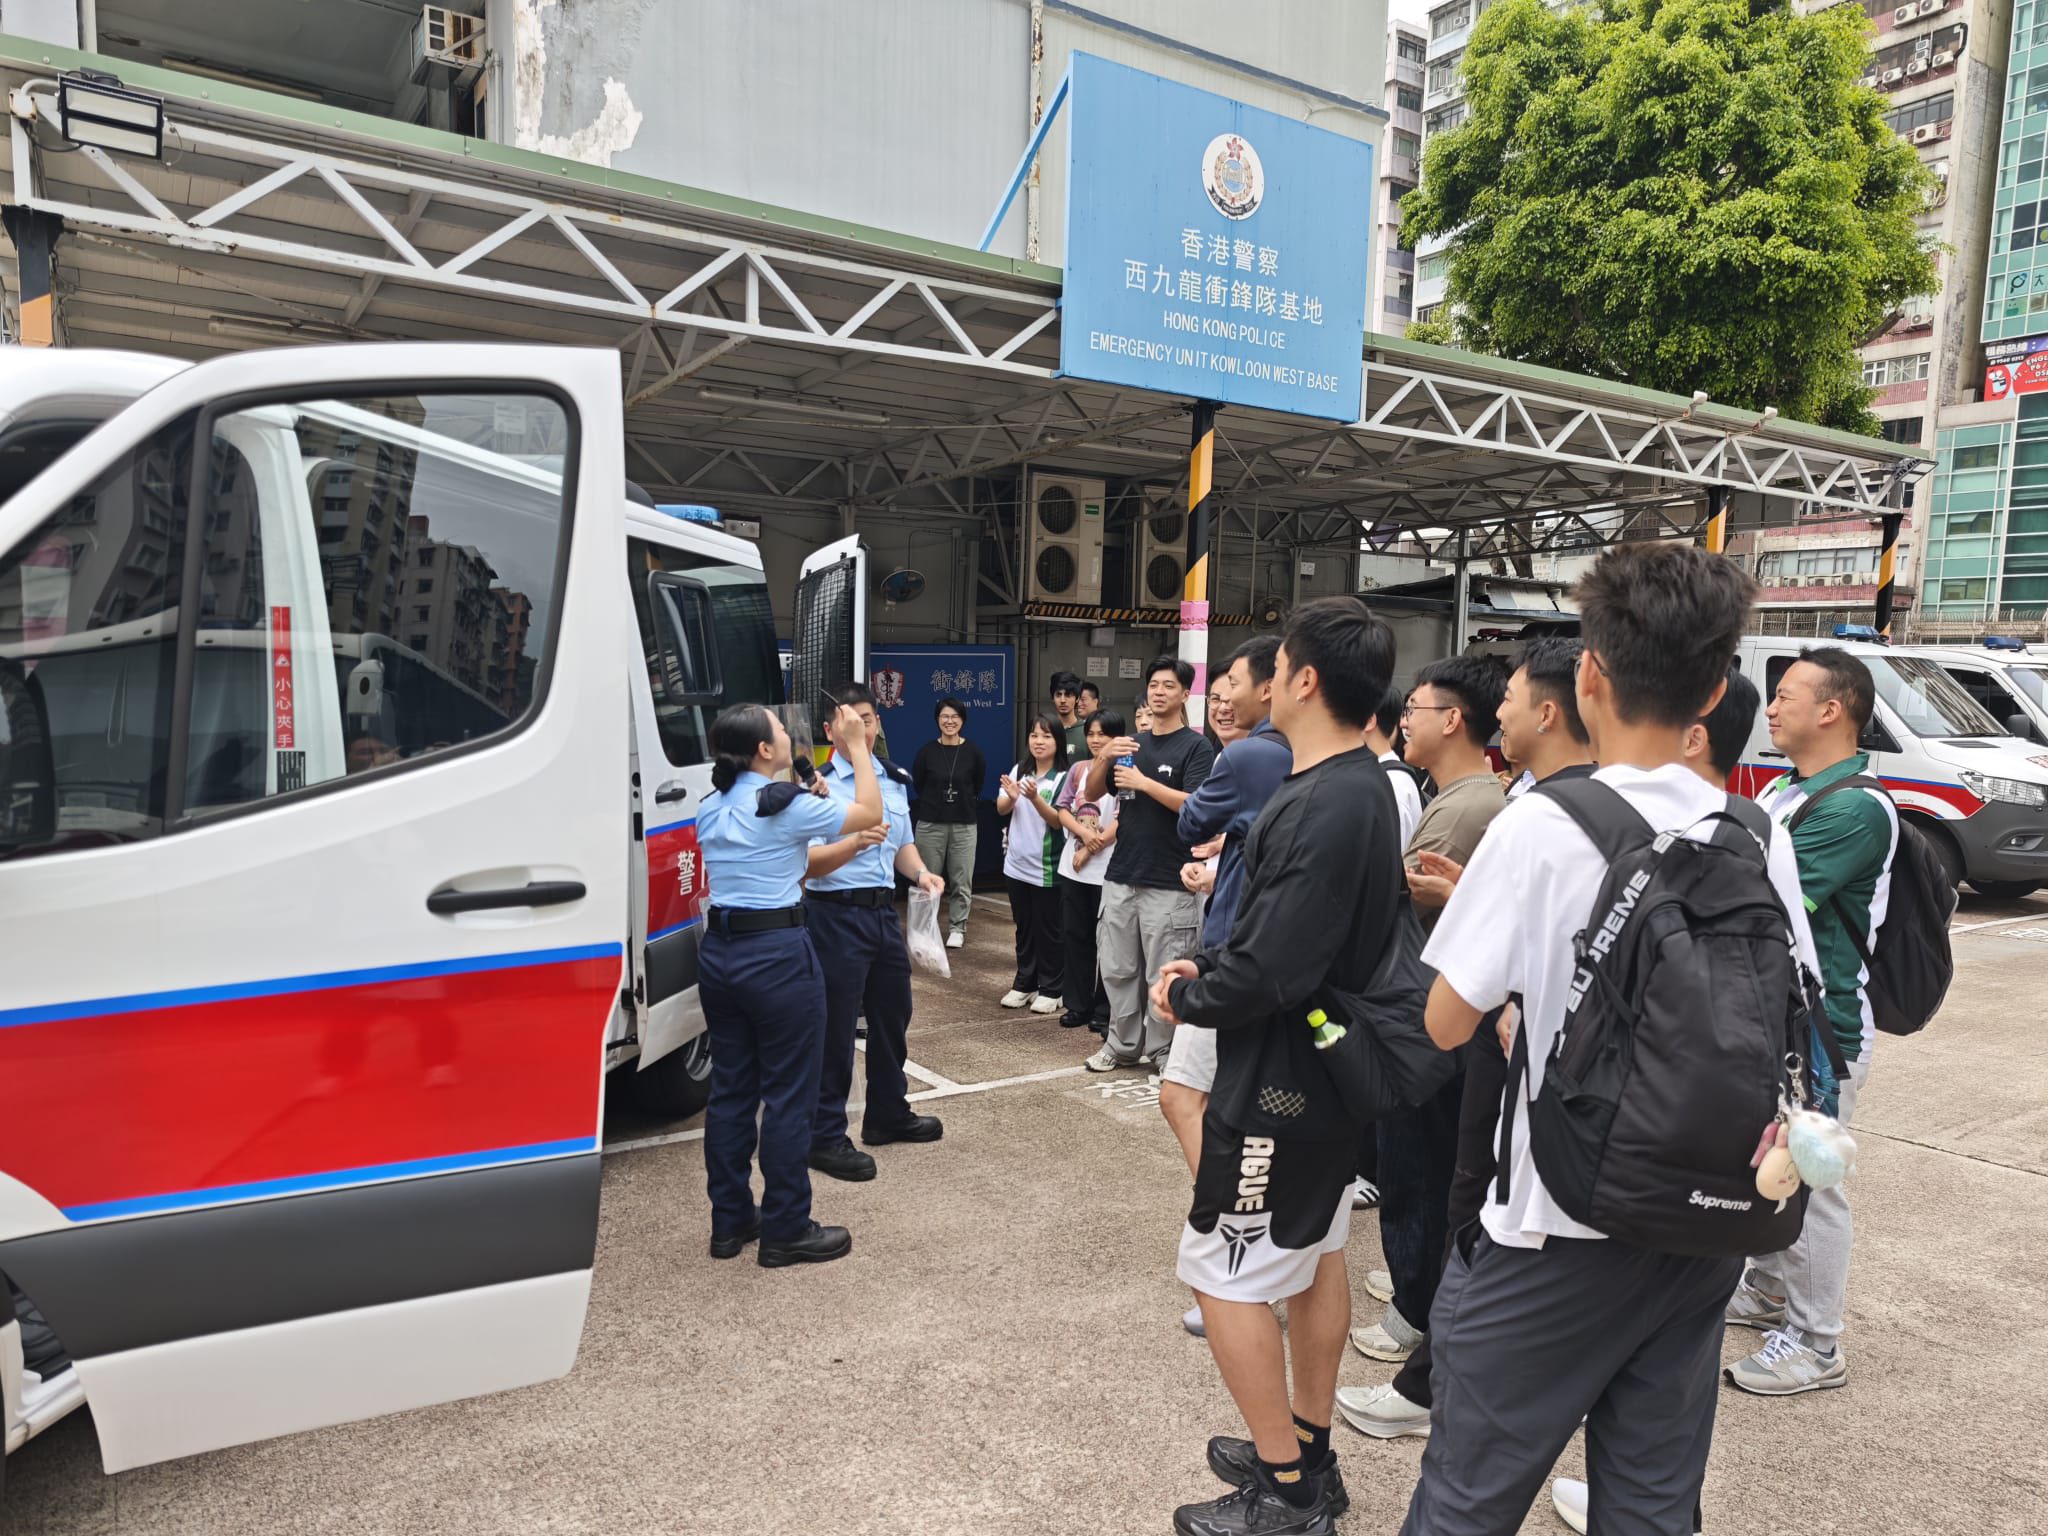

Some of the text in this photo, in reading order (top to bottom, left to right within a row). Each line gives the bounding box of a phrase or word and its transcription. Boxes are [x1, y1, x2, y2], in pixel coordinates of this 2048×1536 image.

[1181, 228, 1279, 277] 香港警察
[1124, 258, 1323, 326] 西九龍衝鋒隊基地
[1163, 311, 1286, 350] HONG KONG POLICE
[1090, 331, 1339, 393] EMERGENCY UNIT KOWLOON WEST BASE
[930, 670, 998, 694] 衝鋒隊
[973, 699, 992, 708] West
[275, 677, 292, 748] 小心夾手
[677, 850, 696, 896] 警
[1688, 1190, 1752, 1211] Supreme
